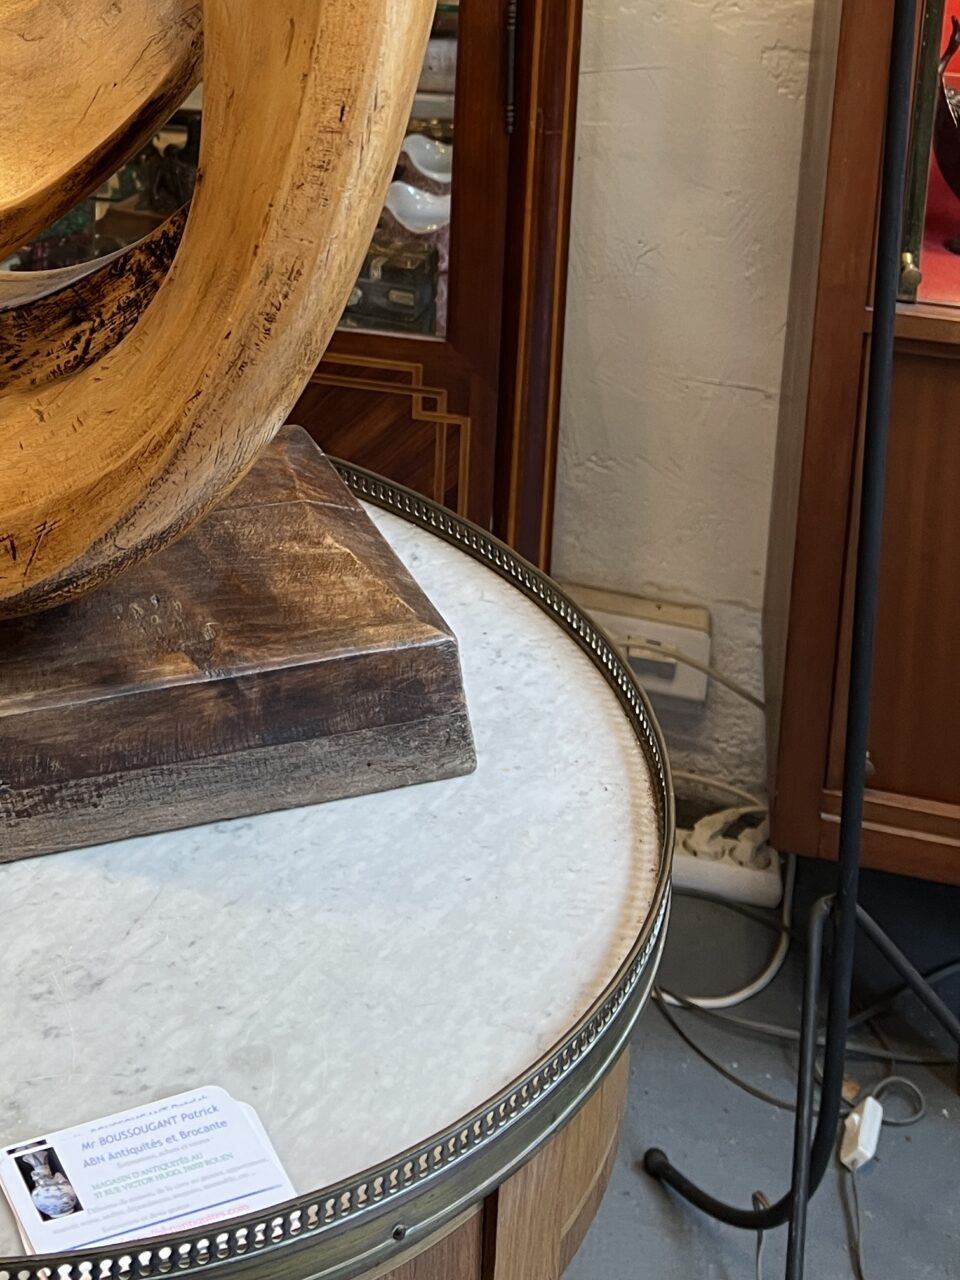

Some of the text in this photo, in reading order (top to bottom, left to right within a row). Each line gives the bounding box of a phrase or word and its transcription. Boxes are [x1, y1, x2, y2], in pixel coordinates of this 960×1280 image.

[80, 1140, 96, 1152] Mr
[98, 1115, 180, 1146] BOUSSOUGANT
[181, 1103, 220, 1123] Patrick
[82, 1155, 106, 1169] ABN
[107, 1137, 163, 1162] Antiquités
[165, 1134, 178, 1145] et
[179, 1119, 228, 1140] Brocante
